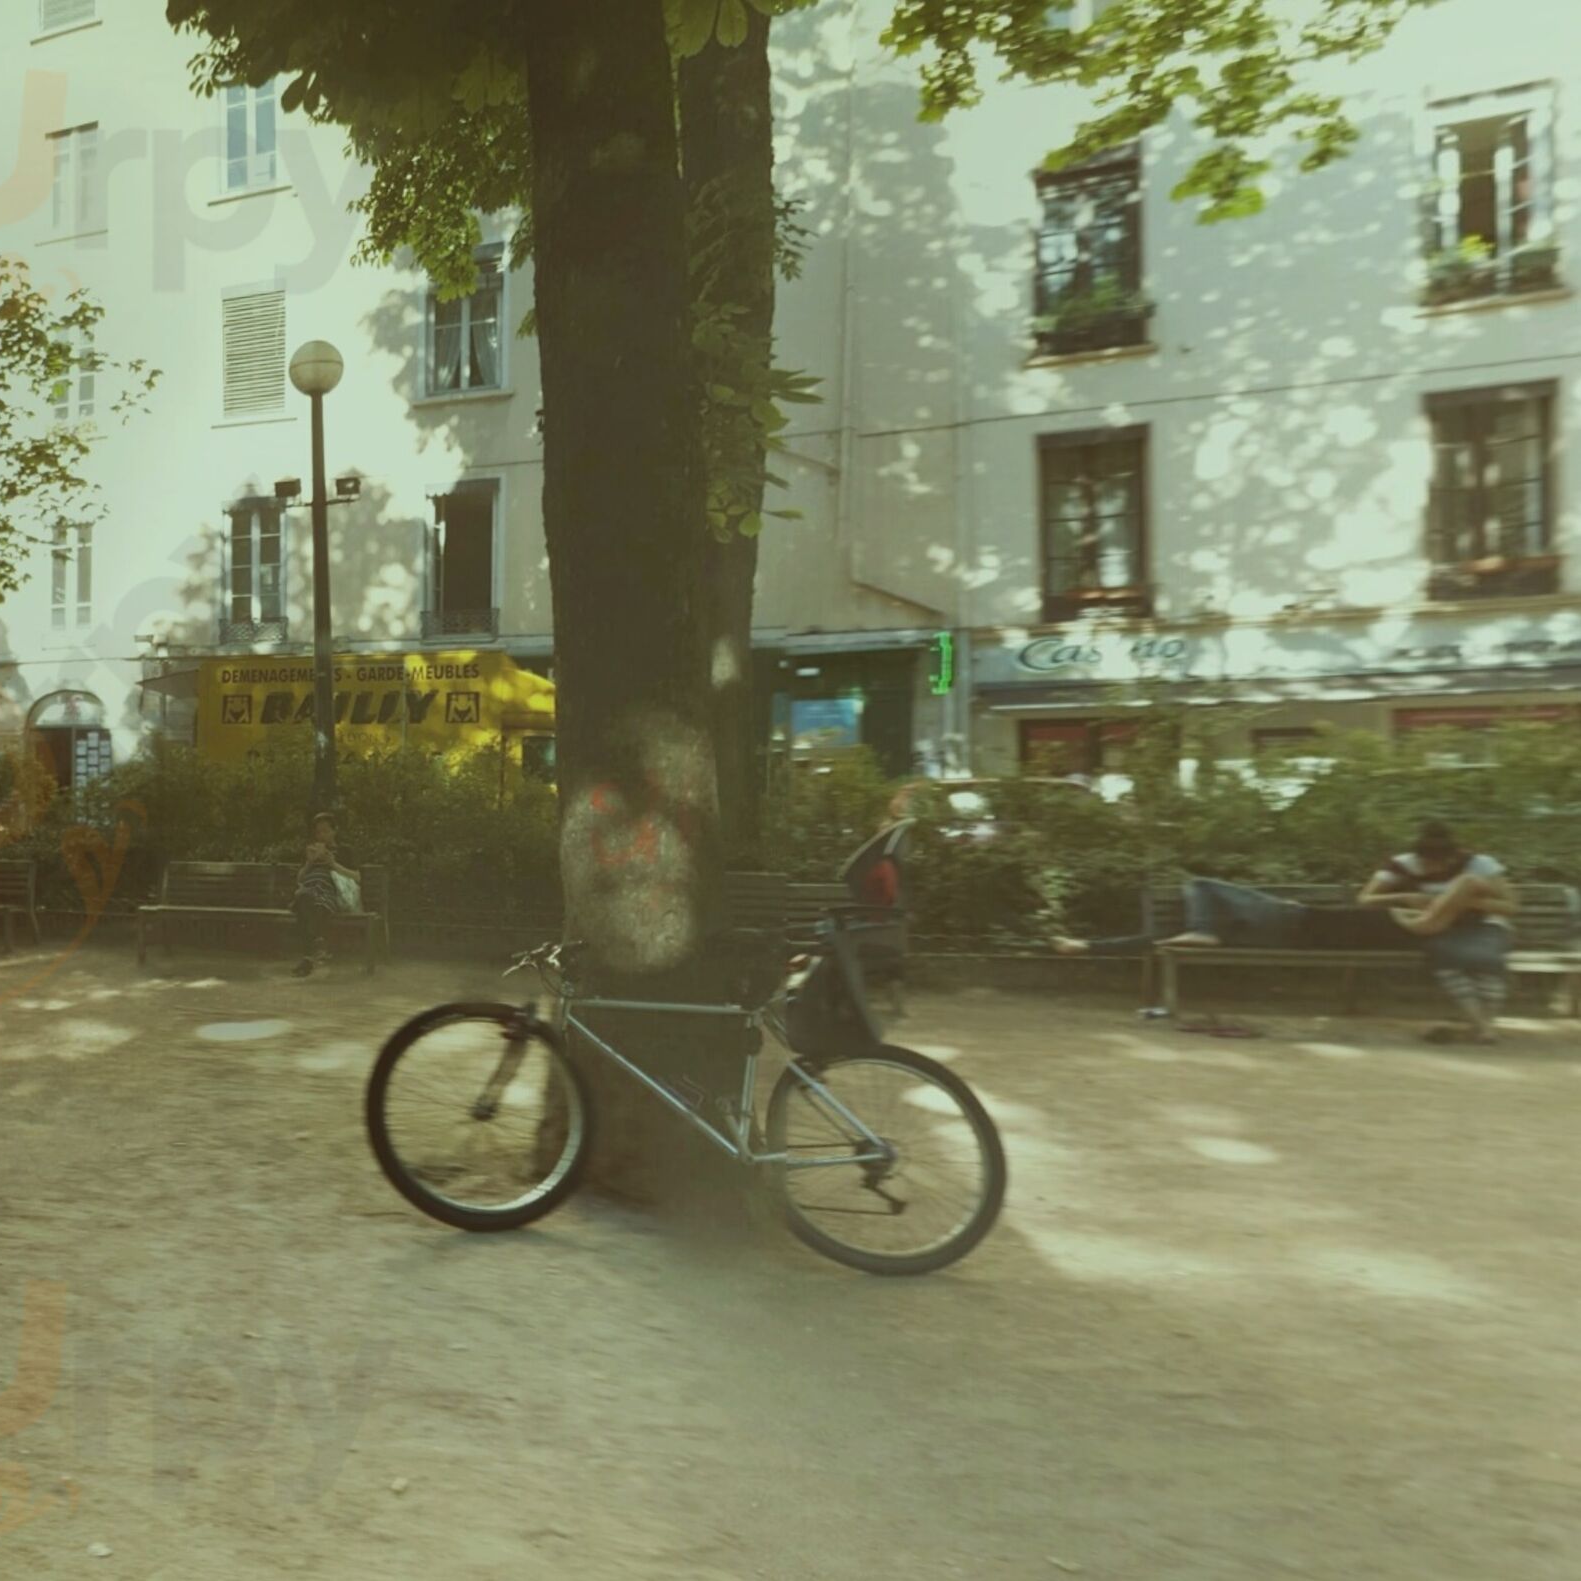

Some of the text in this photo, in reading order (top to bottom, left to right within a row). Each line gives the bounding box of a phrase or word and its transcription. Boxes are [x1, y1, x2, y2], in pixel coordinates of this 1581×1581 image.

[1017, 636, 1187, 672] Casno
[221, 667, 342, 684] DEMENAGEMES
[356, 664, 479, 682] GARDE-MEUBLES
